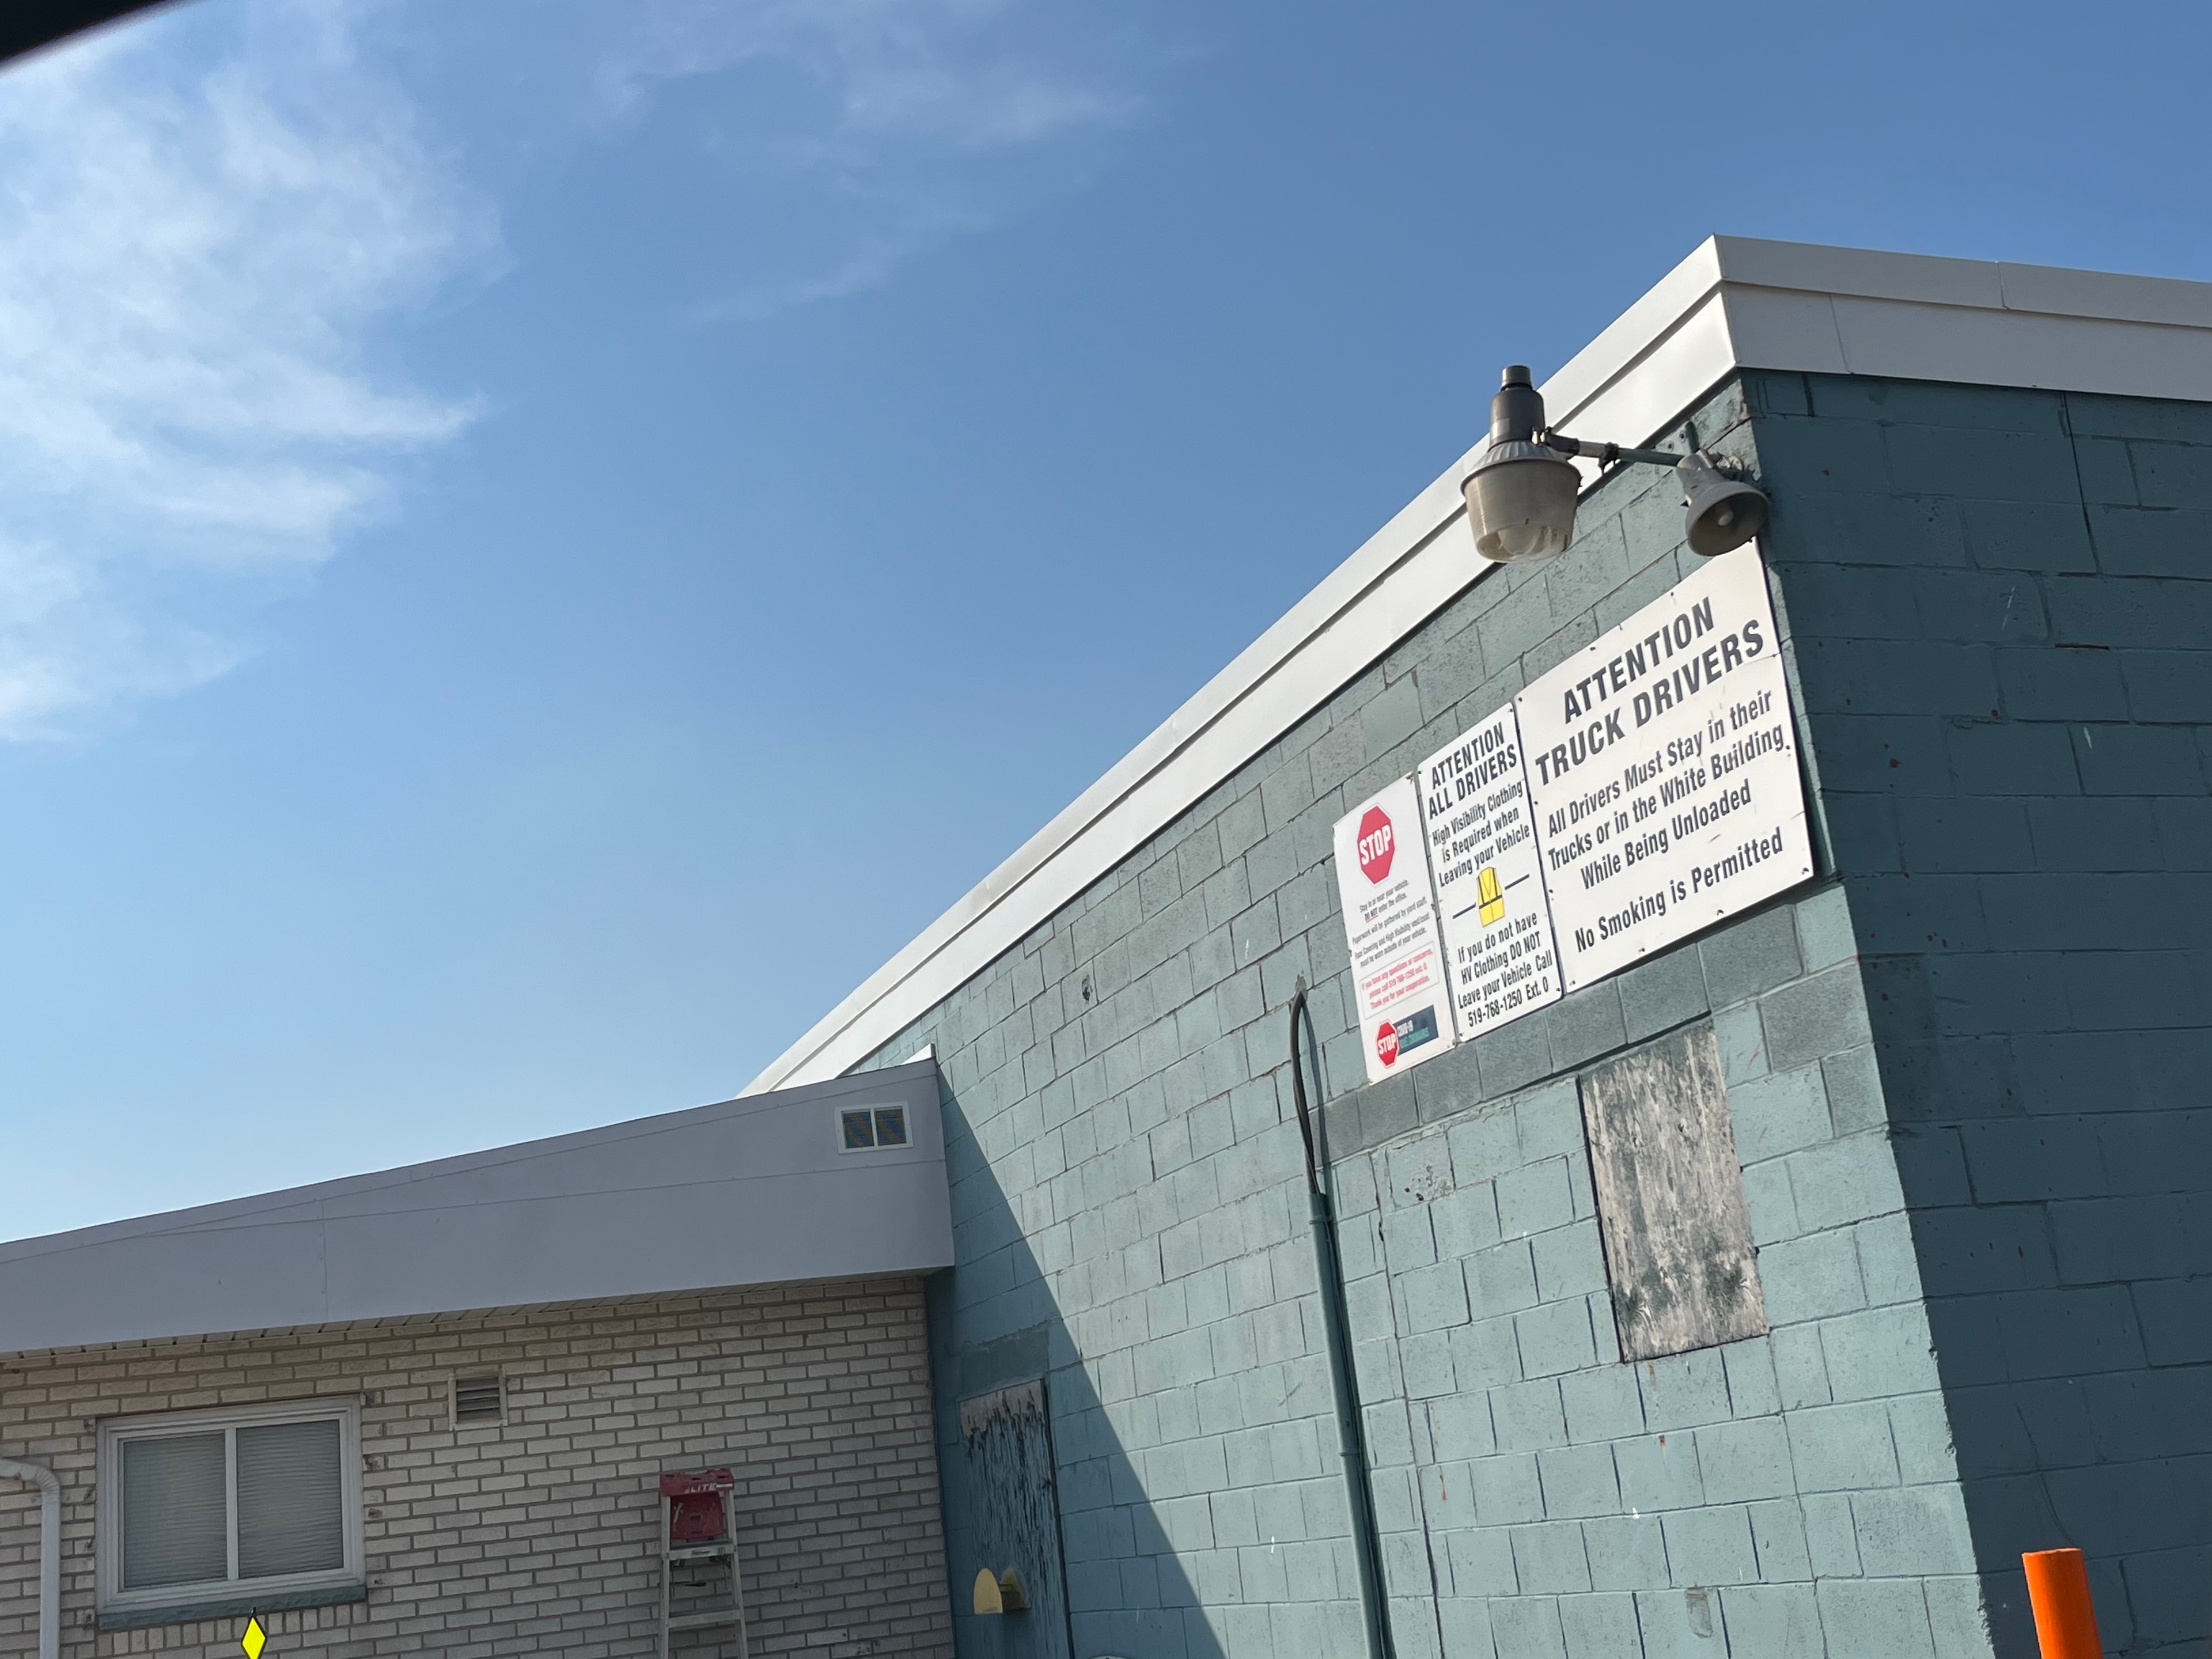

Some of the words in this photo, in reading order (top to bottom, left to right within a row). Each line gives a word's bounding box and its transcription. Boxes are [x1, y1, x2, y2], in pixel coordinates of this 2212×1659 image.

[1565, 597, 1714, 724] ATTENTION
[1535, 707, 1625, 786] TRUCK
[1633, 620, 1763, 728] DRIVERS
[1429, 787, 1453, 820] ALL
[1456, 744, 1517, 801] DRIVERS
[1432, 722, 1504, 790] ATTENTION
[1549, 808, 1566, 838] All
[1569, 781, 1620, 824] Drivers
[1624, 751, 1663, 792] Must
[1667, 731, 1702, 766] Stay
[1708, 719, 1725, 744] in
[1730, 690, 1771, 730] their
[1432, 824, 1450, 846] High
[1450, 804, 1486, 834] Visibility
[1487, 781, 1522, 812] Clothing
[1548, 833, 1592, 870] Trucks
[1597, 821, 1609, 844] or
[1614, 811, 1628, 834] in
[1633, 796, 1657, 823] the
[1660, 768, 1706, 807] White
[1711, 725, 1783, 780] Building
[1359, 824, 1392, 866] STOP
[1439, 859, 1472, 887] Leaving
[1474, 846, 1494, 870] your
[1495, 824, 1529, 854] Vehicle
[1442, 849, 1450, 863] is
[1452, 820, 1492, 857] Required
[1494, 808, 1519, 831] when
[1581, 854, 1621, 889] While
[1624, 828, 1668, 866] Being
[1672, 778, 1751, 840] Unloaded
[1575, 927, 1594, 952] No
[1599, 891, 1666, 940] Smoking
[1670, 880, 1686, 903] is
[1691, 826, 1782, 893] Permitted
[1458, 946, 1465, 963] If
[1467, 941, 1483, 962] you
[1485, 934, 1495, 950] do
[1498, 922, 1513, 943] not
[1514, 913, 1537, 934] have
[1461, 966, 1472, 984] HV
[1474, 952, 1509, 978] Clothing
[1510, 941, 1521, 960] DO
[1524, 931, 1540, 953] NOT
[1458, 988, 1480, 1009] Leave
[1482, 979, 1500, 1001] your
[1501, 962, 1532, 987] Vehicle
[1536, 949, 1552, 971] Call
[1468, 988, 1522, 1027] 519-768-1250
[1525, 981, 1541, 1000] Ext.
[1543, 976, 1548, 992] 0
[1378, 1033, 1396, 1055] STOP
